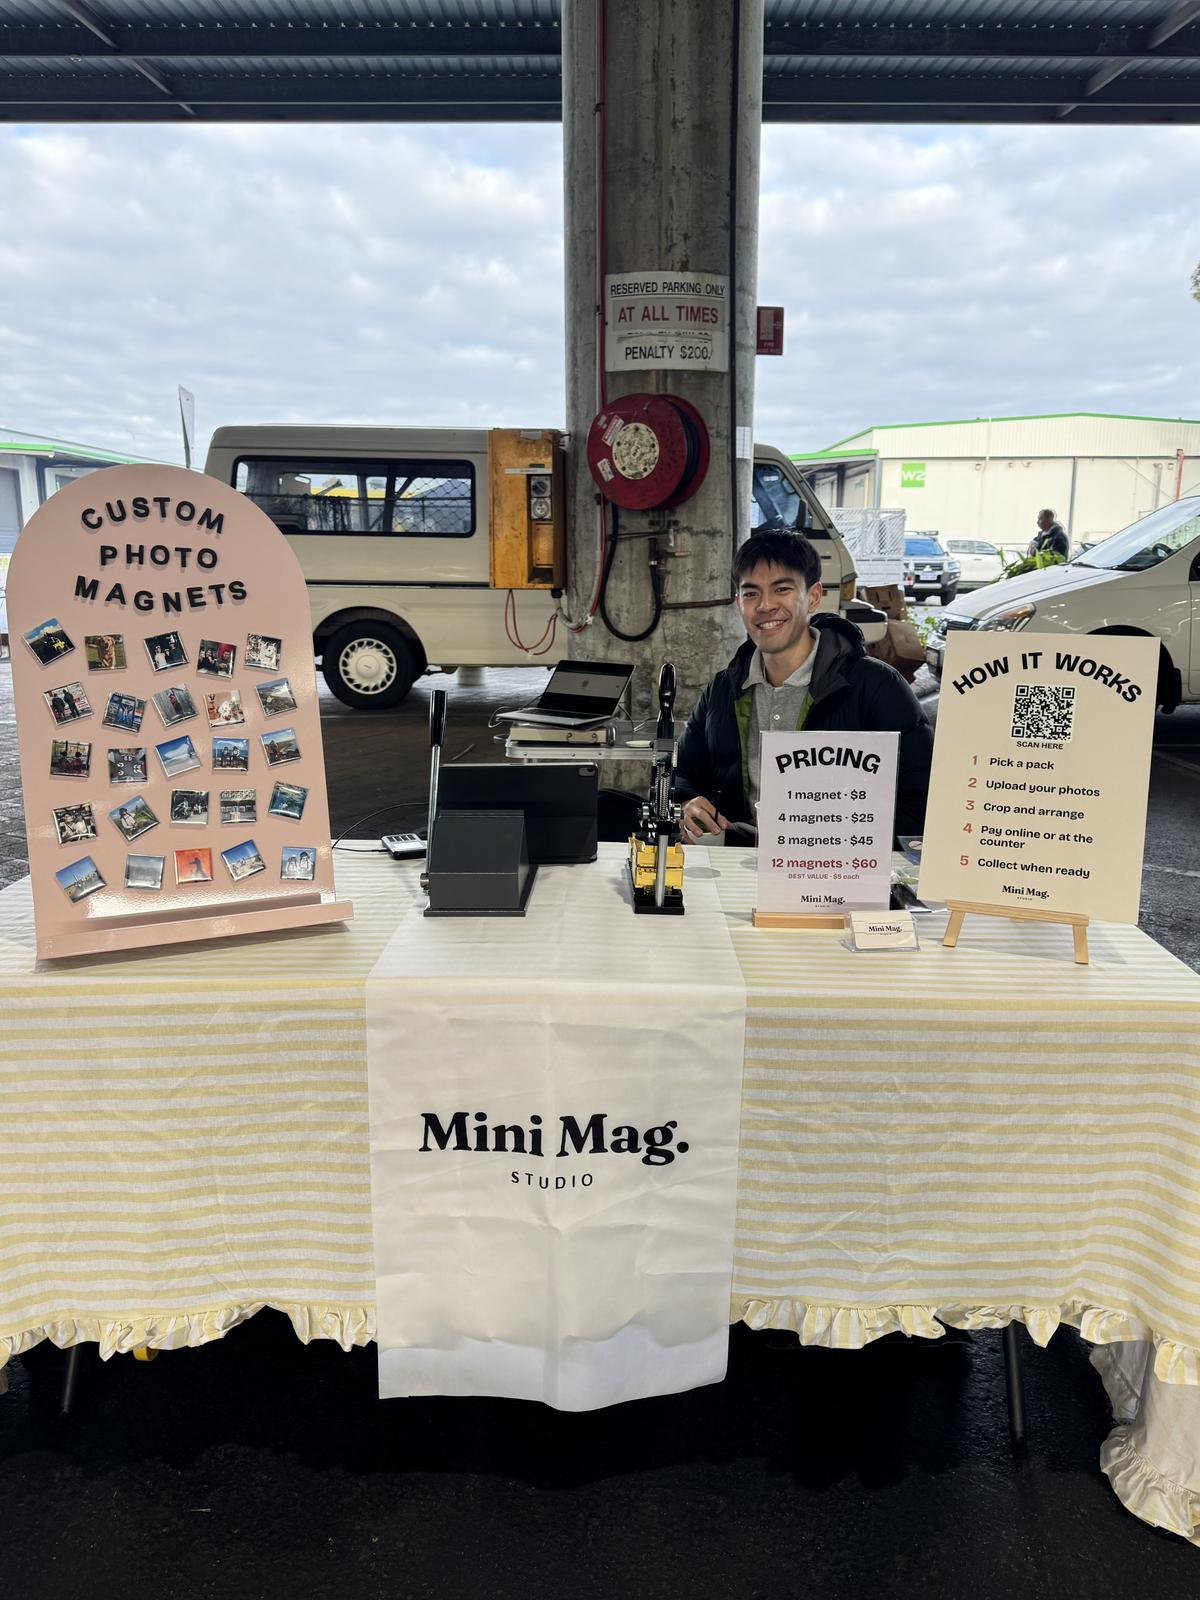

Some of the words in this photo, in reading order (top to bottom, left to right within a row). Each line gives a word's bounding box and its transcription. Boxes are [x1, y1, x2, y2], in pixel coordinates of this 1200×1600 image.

[610, 282, 658, 295] RESERVED
[662, 281, 701, 294] PARKING
[705, 283, 726, 295] ONLY
[618, 306, 636, 323] AT
[641, 305, 670, 321] ALL
[675, 305, 719, 324] TIMES
[625, 345, 675, 360] PENALTY
[902, 470, 925, 480] W2
[81, 497, 225, 534] CUSTOM
[100, 544, 218, 568] PHOTO
[74, 575, 248, 613] MAGNETS
[952, 656, 1010, 695] HOW
[1021, 652, 1043, 670] IT
[1055, 652, 1142, 703] WORKS
[1016, 740, 1040, 749] SCAN
[1041, 742, 1064, 750] HERE
[775, 746, 881, 775] PRICING
[972, 755, 978, 766] 1
[990, 757, 1014, 768] Pick
[1016, 760, 1024, 768] a
[1025, 761, 1055, 770] pack
[968, 777, 977, 788] 2
[986, 780, 1027, 791] Upload
[1029, 784, 1056, 794] your
[1058, 785, 1101, 797] photos
[787, 790, 792, 799] 1
[795, 790, 842, 802] magnet
[850, 789, 867, 801] $8
[965, 800, 975, 811] 3
[983, 802, 1011, 814] Crop
[1013, 806, 1036, 815] and
[1038, 809, 1085, 820] arrange
[778, 813, 786, 822] 4
[789, 813, 842, 824] magnets
[851, 812, 874, 824] $25
[777, 835, 785, 845] 8
[788, 836, 842, 847] magnets
[850, 835, 874, 846] $45
[963, 823, 973, 834] 4
[981, 825, 1003, 837] Pay
[1005, 828, 1041, 839] online
[1043, 831, 1057, 840] or
[1058, 831, 1072, 842] at
[1073, 833, 1094, 844] the
[979, 838, 1026, 849] counter
[771, 858, 784, 868] 12
[786, 858, 843, 870] magnets
[851, 857, 877, 870] $60
[960, 855, 969, 866] 5
[977, 858, 1018, 870] Collect
[1020, 863, 1053, 874] when
[1055, 867, 1091, 880] ready
[1002, 885, 1025, 895] Mini
[1025, 887, 1050, 899] Mag.
[800, 895, 822, 903] Mini
[823, 895, 846, 905] Mag.
[885, 925, 903, 933] Mag.
[418, 1111, 545, 1157] Mini
[555, 1113, 690, 1166] Mag.
[511, 1171, 593, 1189] STUDIO
